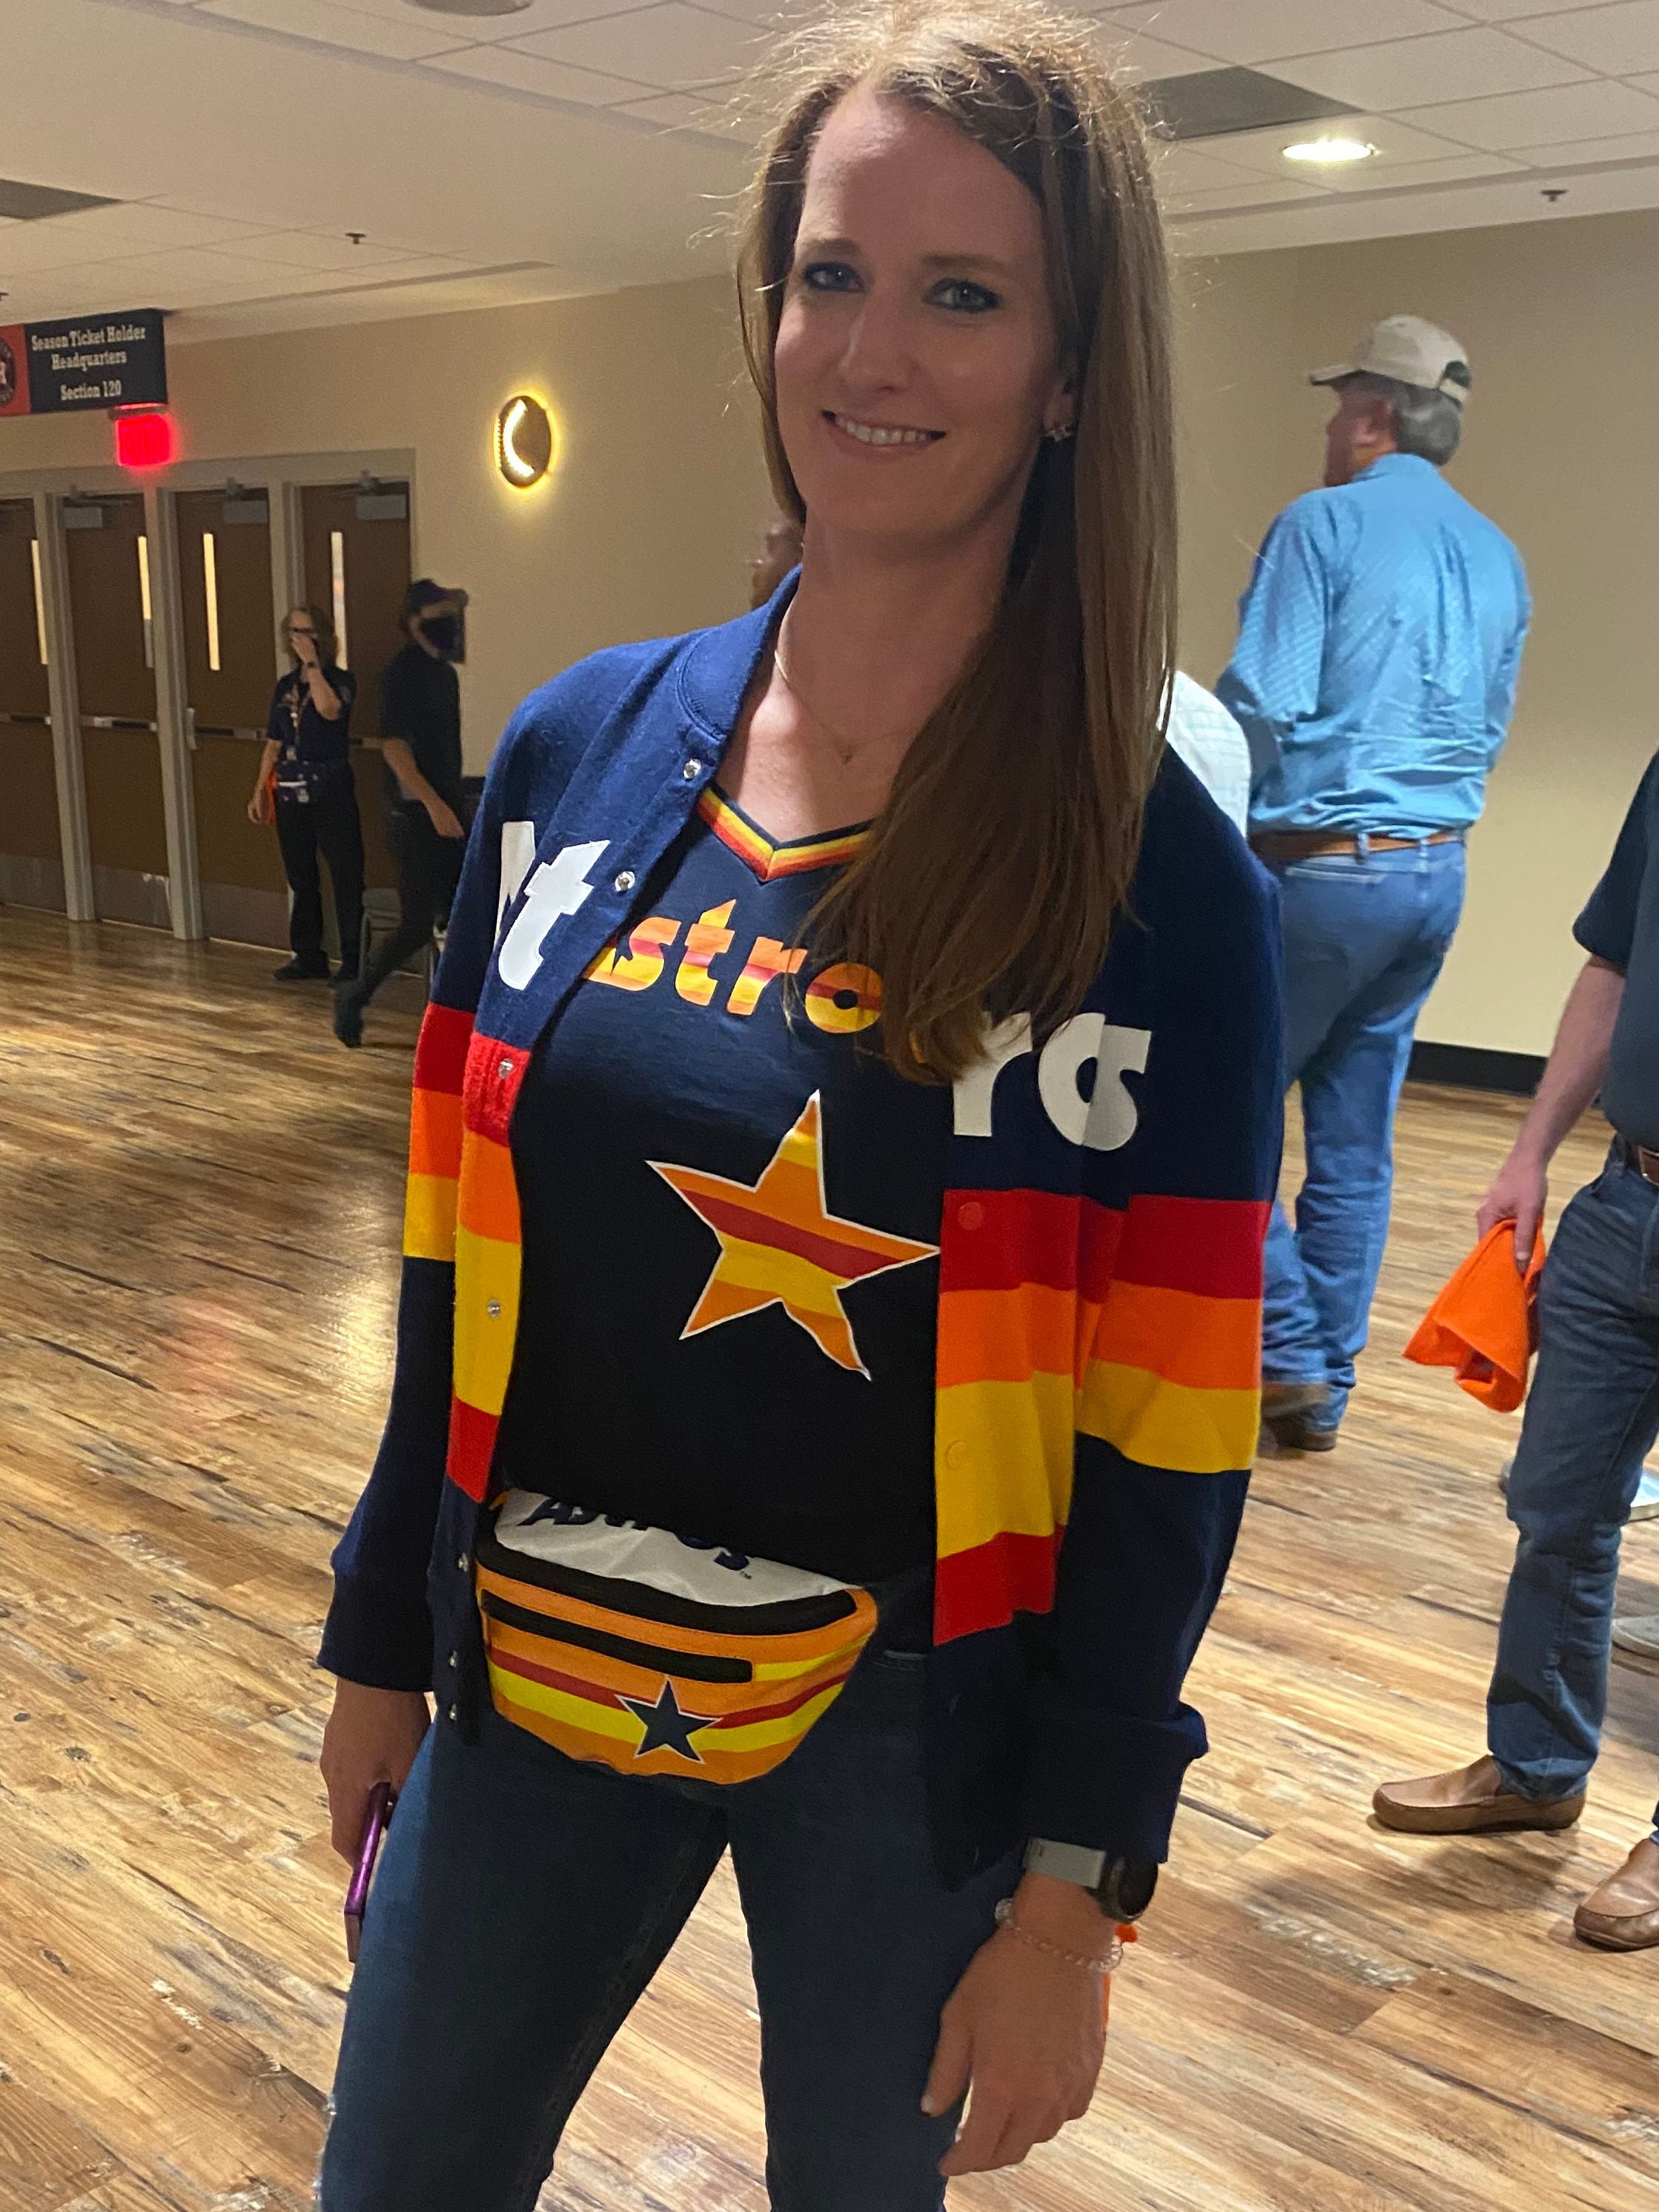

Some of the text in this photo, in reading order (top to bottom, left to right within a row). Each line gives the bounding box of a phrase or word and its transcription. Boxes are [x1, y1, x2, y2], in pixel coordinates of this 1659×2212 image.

[31, 325, 146, 351] Season Ticket Holder
[51, 351, 127, 372] Headquarters
[60, 380, 122, 401] Section 120
